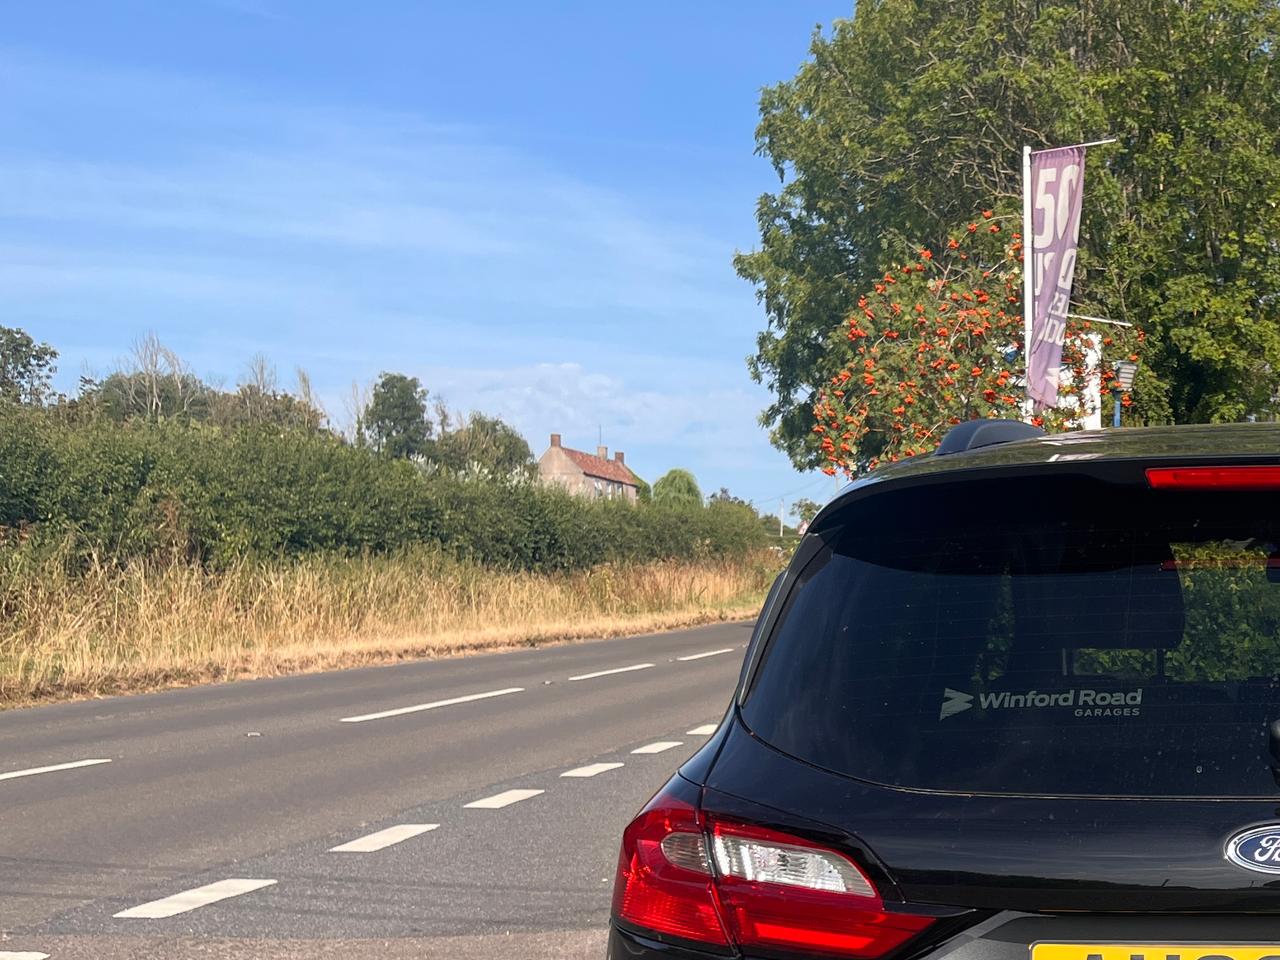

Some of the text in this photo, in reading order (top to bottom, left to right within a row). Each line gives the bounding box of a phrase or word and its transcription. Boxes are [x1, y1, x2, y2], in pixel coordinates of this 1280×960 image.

[979, 688, 1143, 709] Winford Road
[1074, 708, 1141, 717] GARAGES
